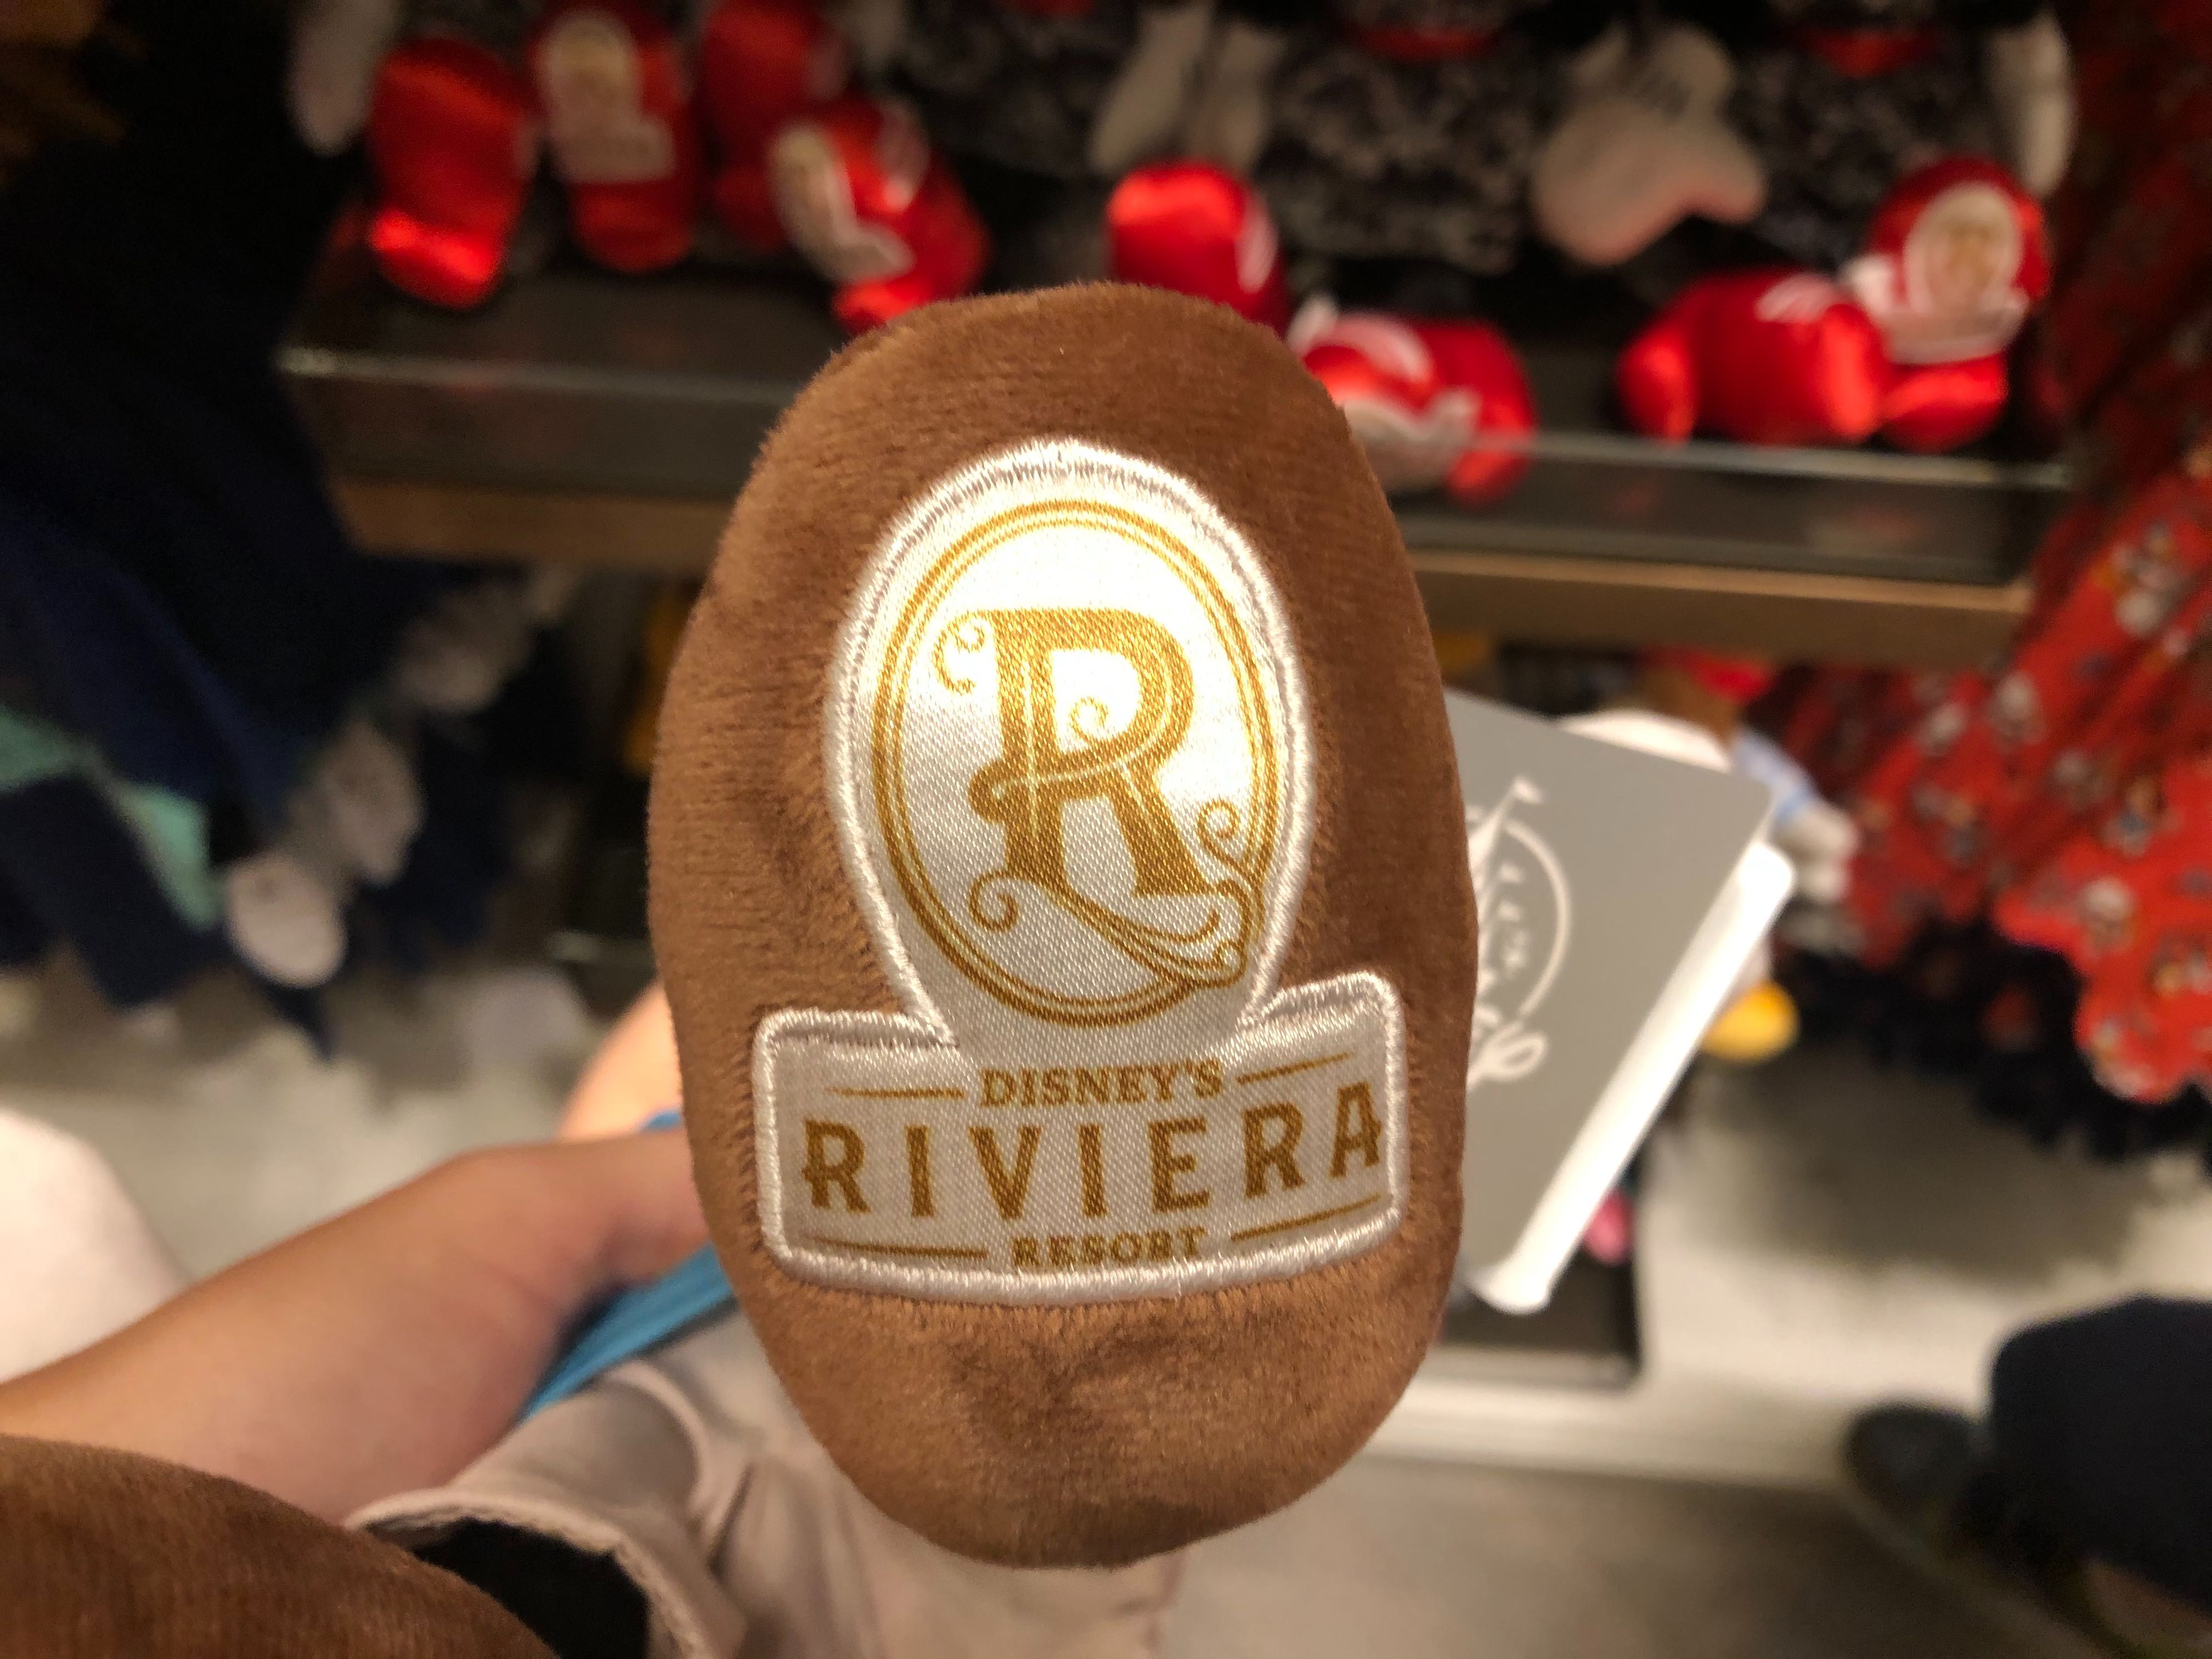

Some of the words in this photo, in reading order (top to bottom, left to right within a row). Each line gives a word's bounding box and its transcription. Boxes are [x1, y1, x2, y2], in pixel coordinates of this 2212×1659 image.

[933, 607, 1246, 988] R
[979, 1059, 1224, 1107] DISNEY'S
[802, 1081, 1383, 1220] RIVIERA
[1012, 1225, 1207, 1268] RESORT
